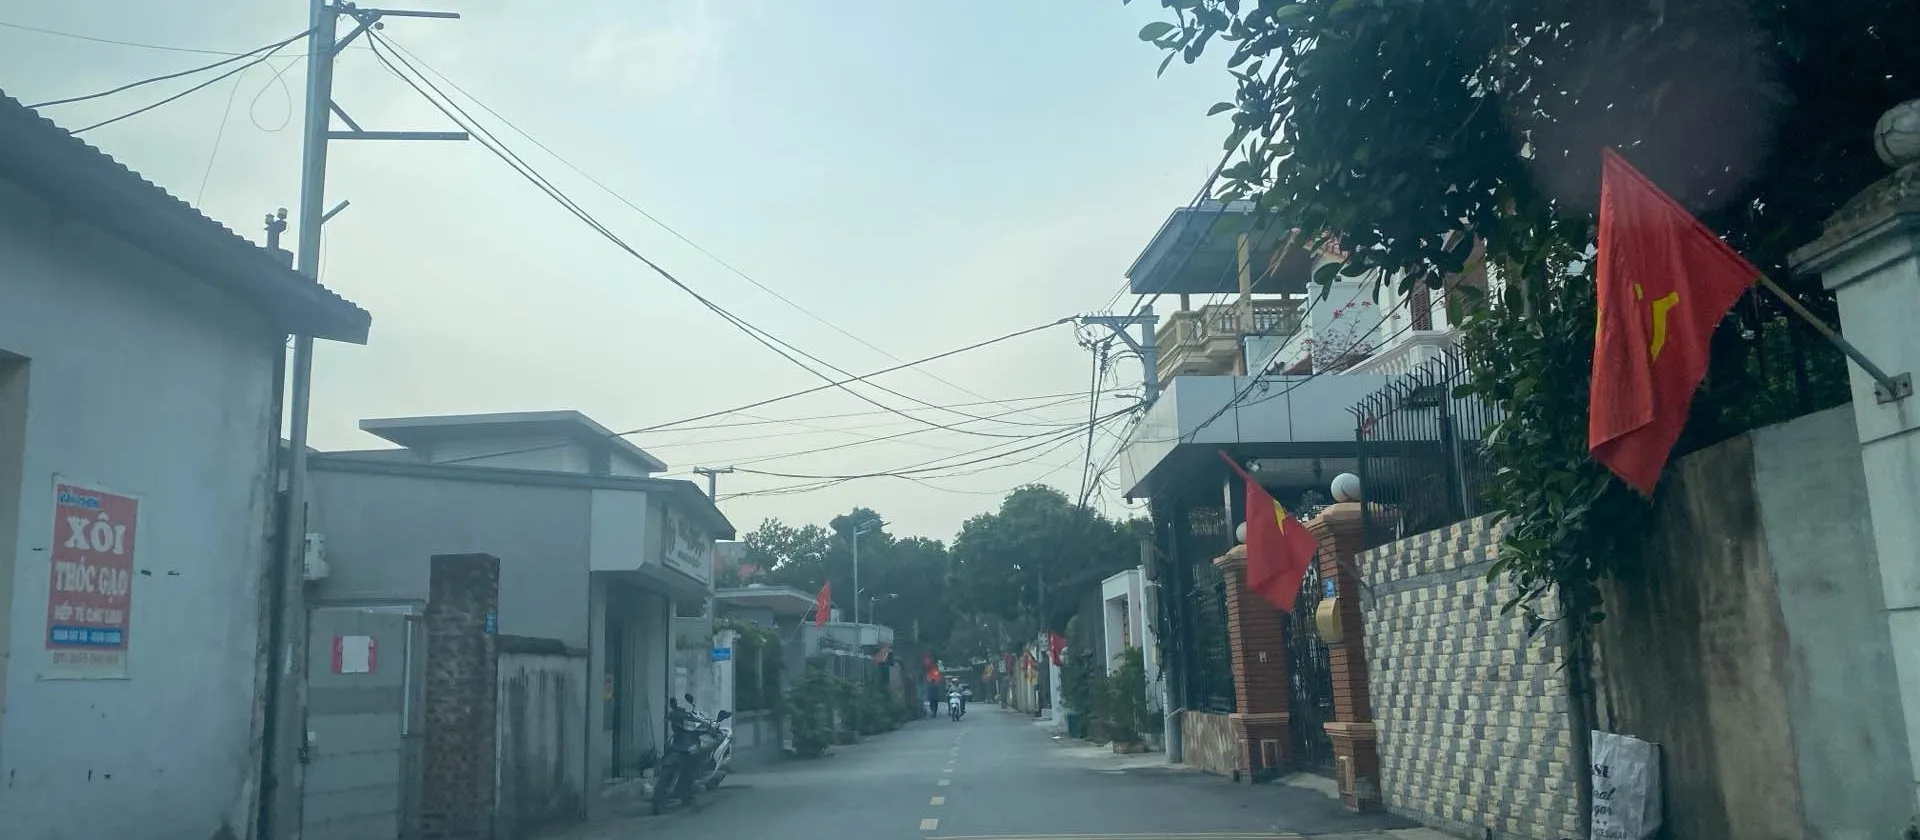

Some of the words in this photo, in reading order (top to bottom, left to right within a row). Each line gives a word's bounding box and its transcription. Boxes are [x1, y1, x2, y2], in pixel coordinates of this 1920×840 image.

[64, 512, 126, 555] XÔI
[56, 556, 95, 592] THÓC
[98, 567, 128, 603] GẠO
